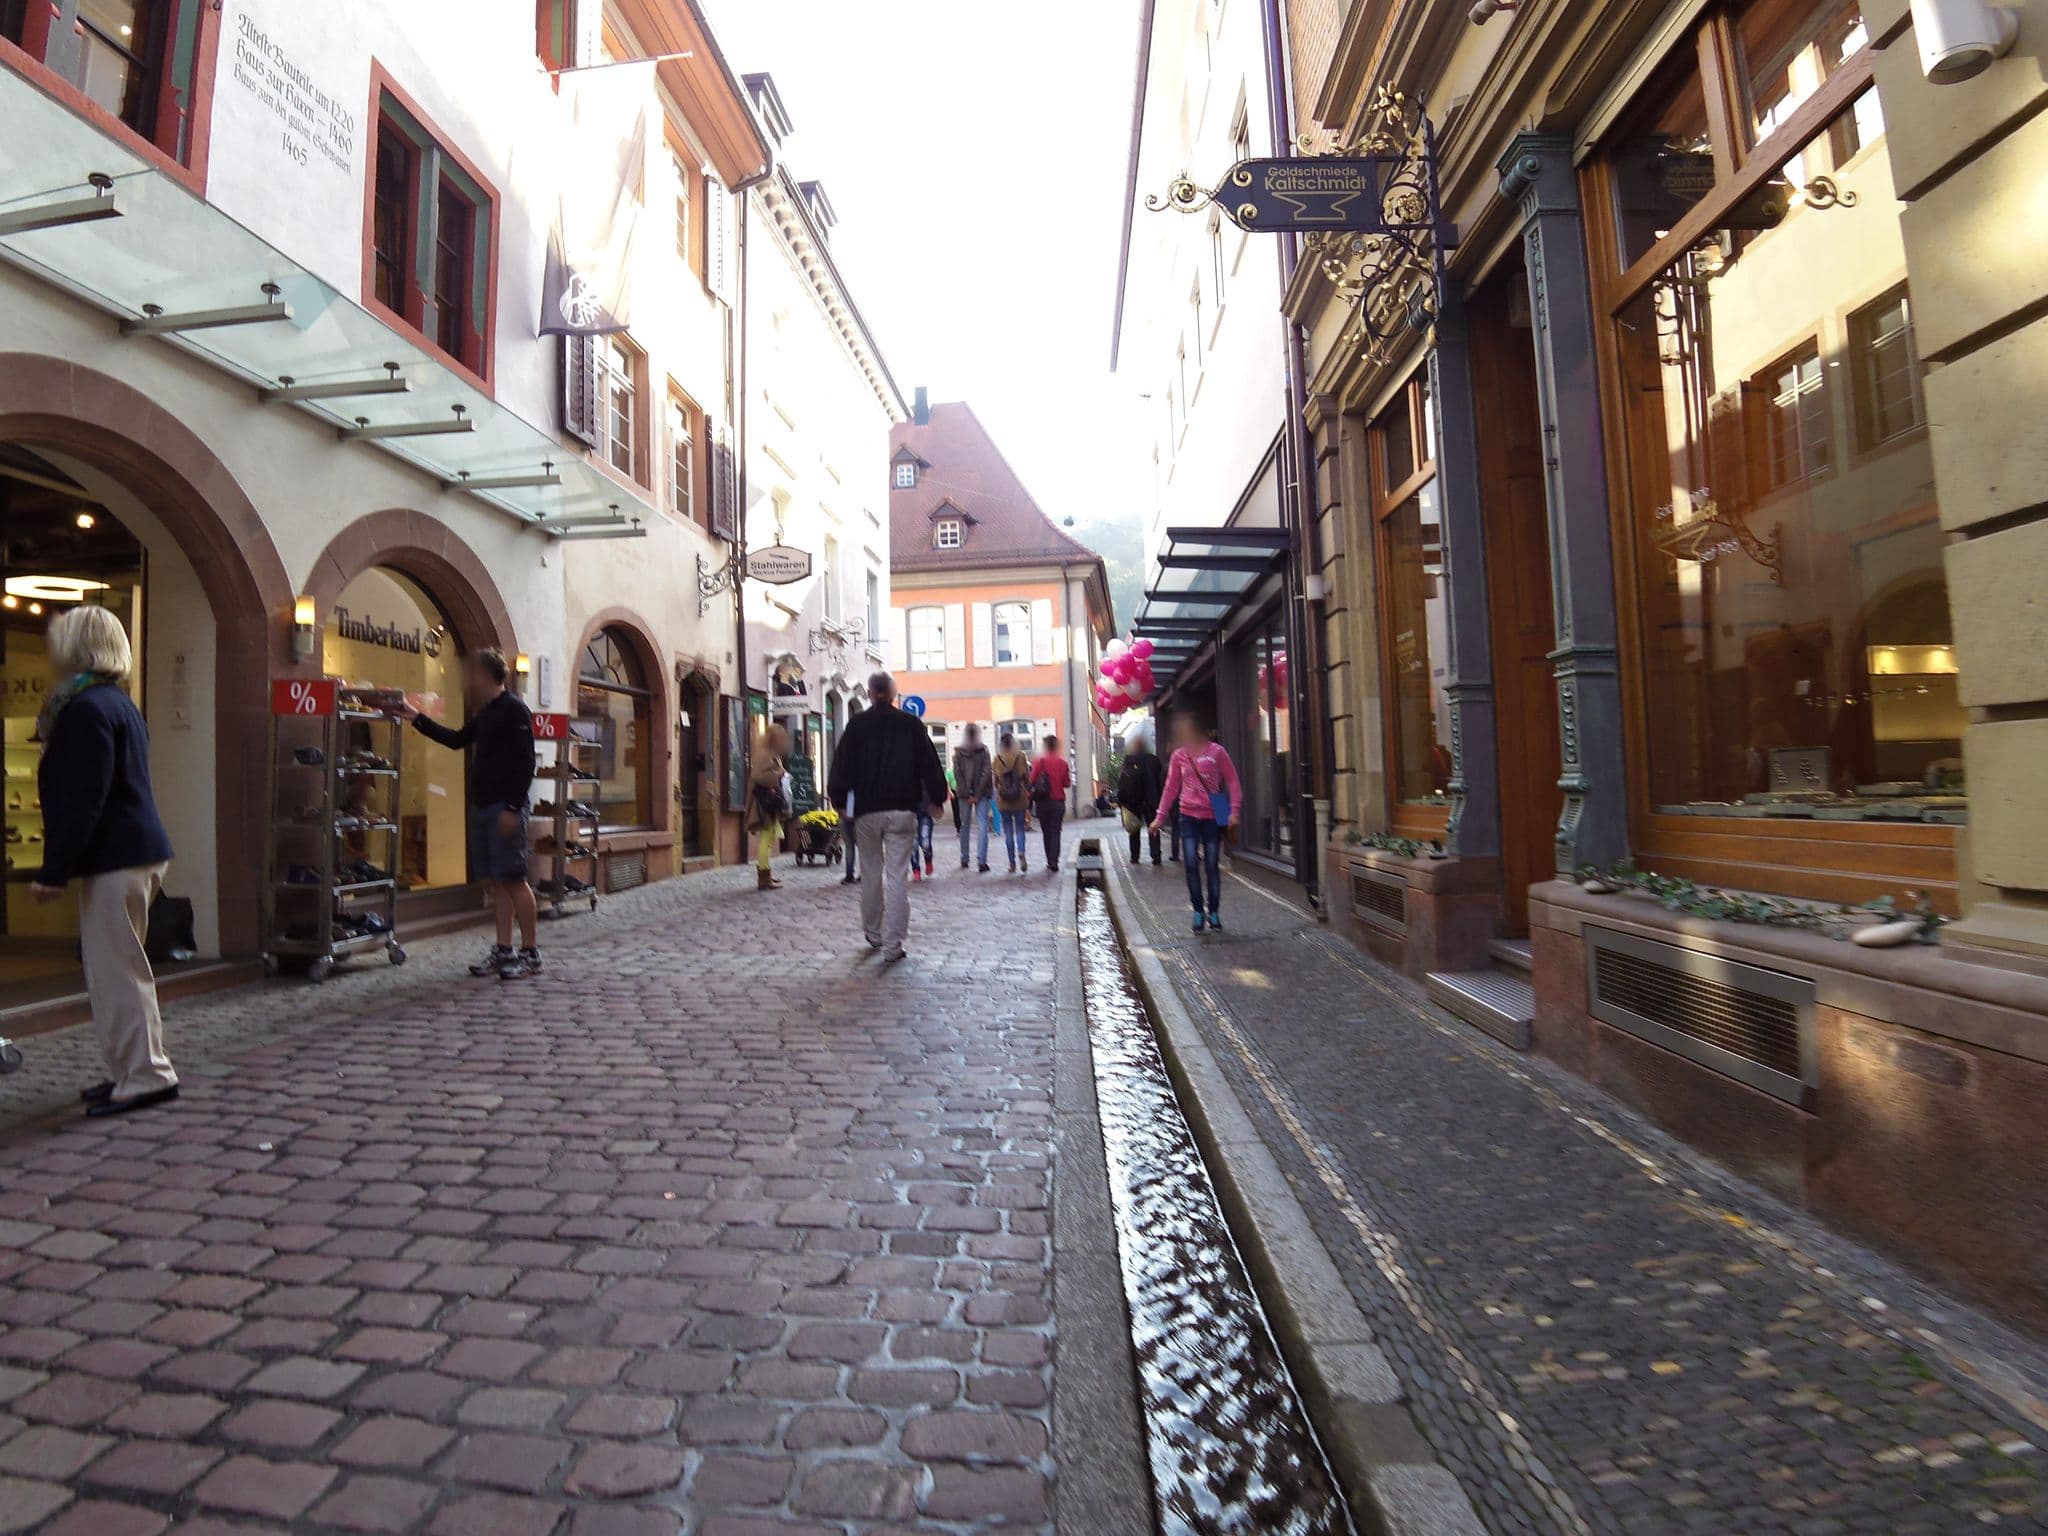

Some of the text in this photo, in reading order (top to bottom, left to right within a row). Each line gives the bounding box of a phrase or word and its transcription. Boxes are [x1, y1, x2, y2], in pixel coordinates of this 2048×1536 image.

[233, 62, 256, 92] Haus
[237, 38, 265, 76] Haus
[266, 69, 284, 95] zur
[315, 88, 329, 112] um
[331, 100, 354, 134] 1220
[1264, 175, 1366, 191] Kaltschmidt
[1268, 167, 1358, 177] Goldschmiede
[750, 560, 805, 570] Stahlwaren
[334, 606, 420, 654] Timberland
[290, 682, 316, 713] %
[536, 715, 554, 737] %
